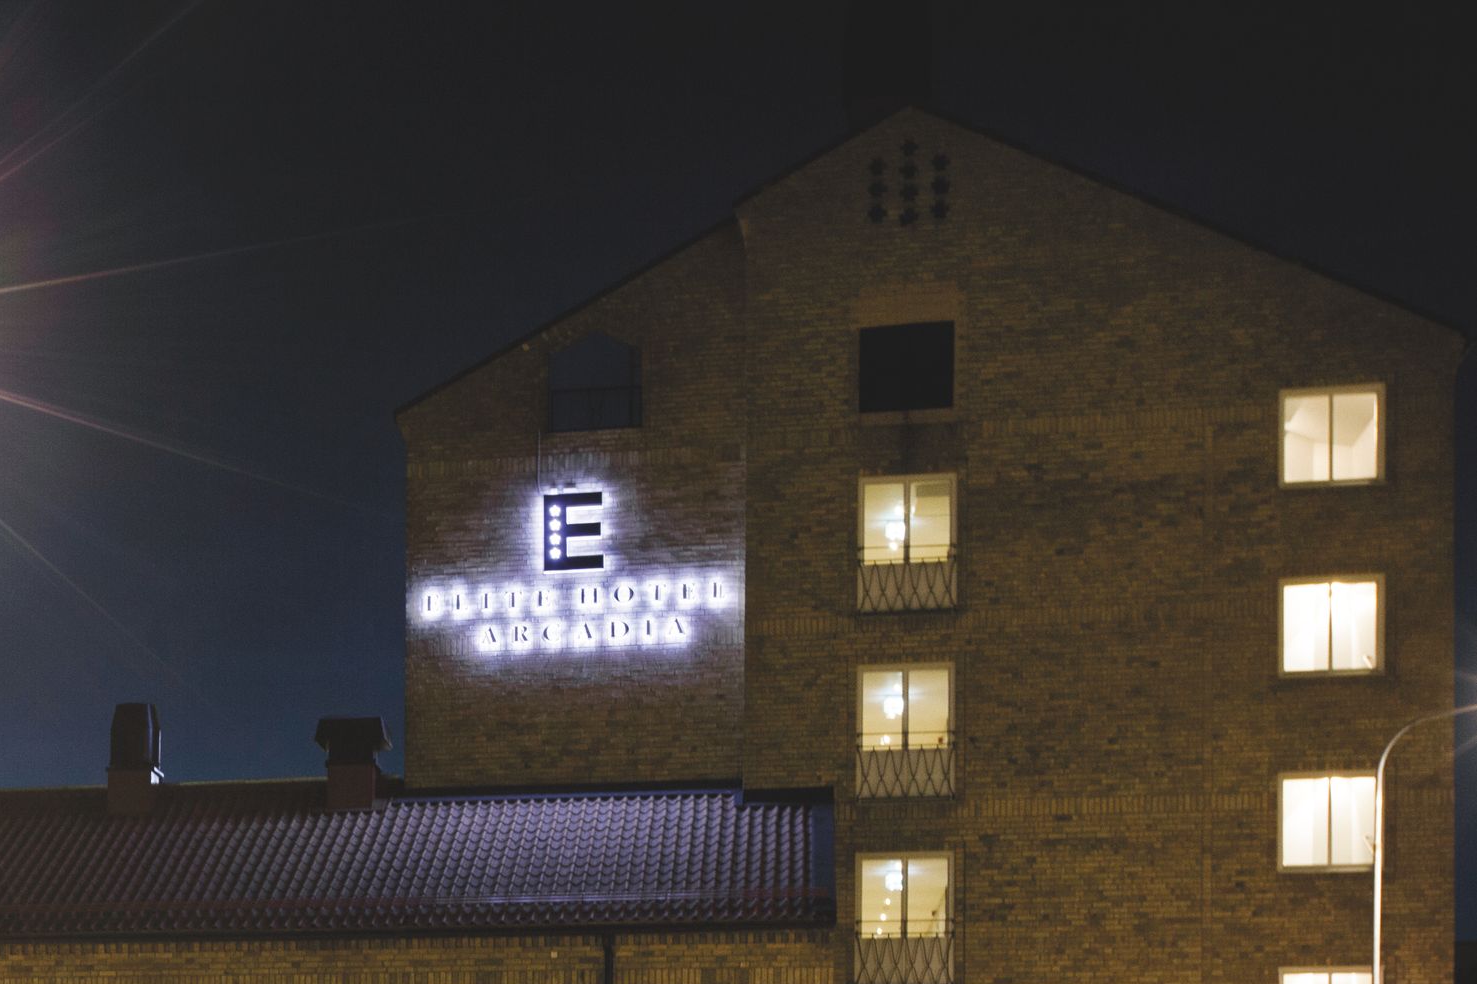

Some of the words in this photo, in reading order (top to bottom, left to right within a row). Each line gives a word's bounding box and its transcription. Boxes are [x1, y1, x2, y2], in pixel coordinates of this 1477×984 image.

[543, 492, 604, 571] E
[426, 589, 552, 612] ELITE
[579, 581, 725, 605] HOTEL
[481, 617, 687, 643] ARCADIA
